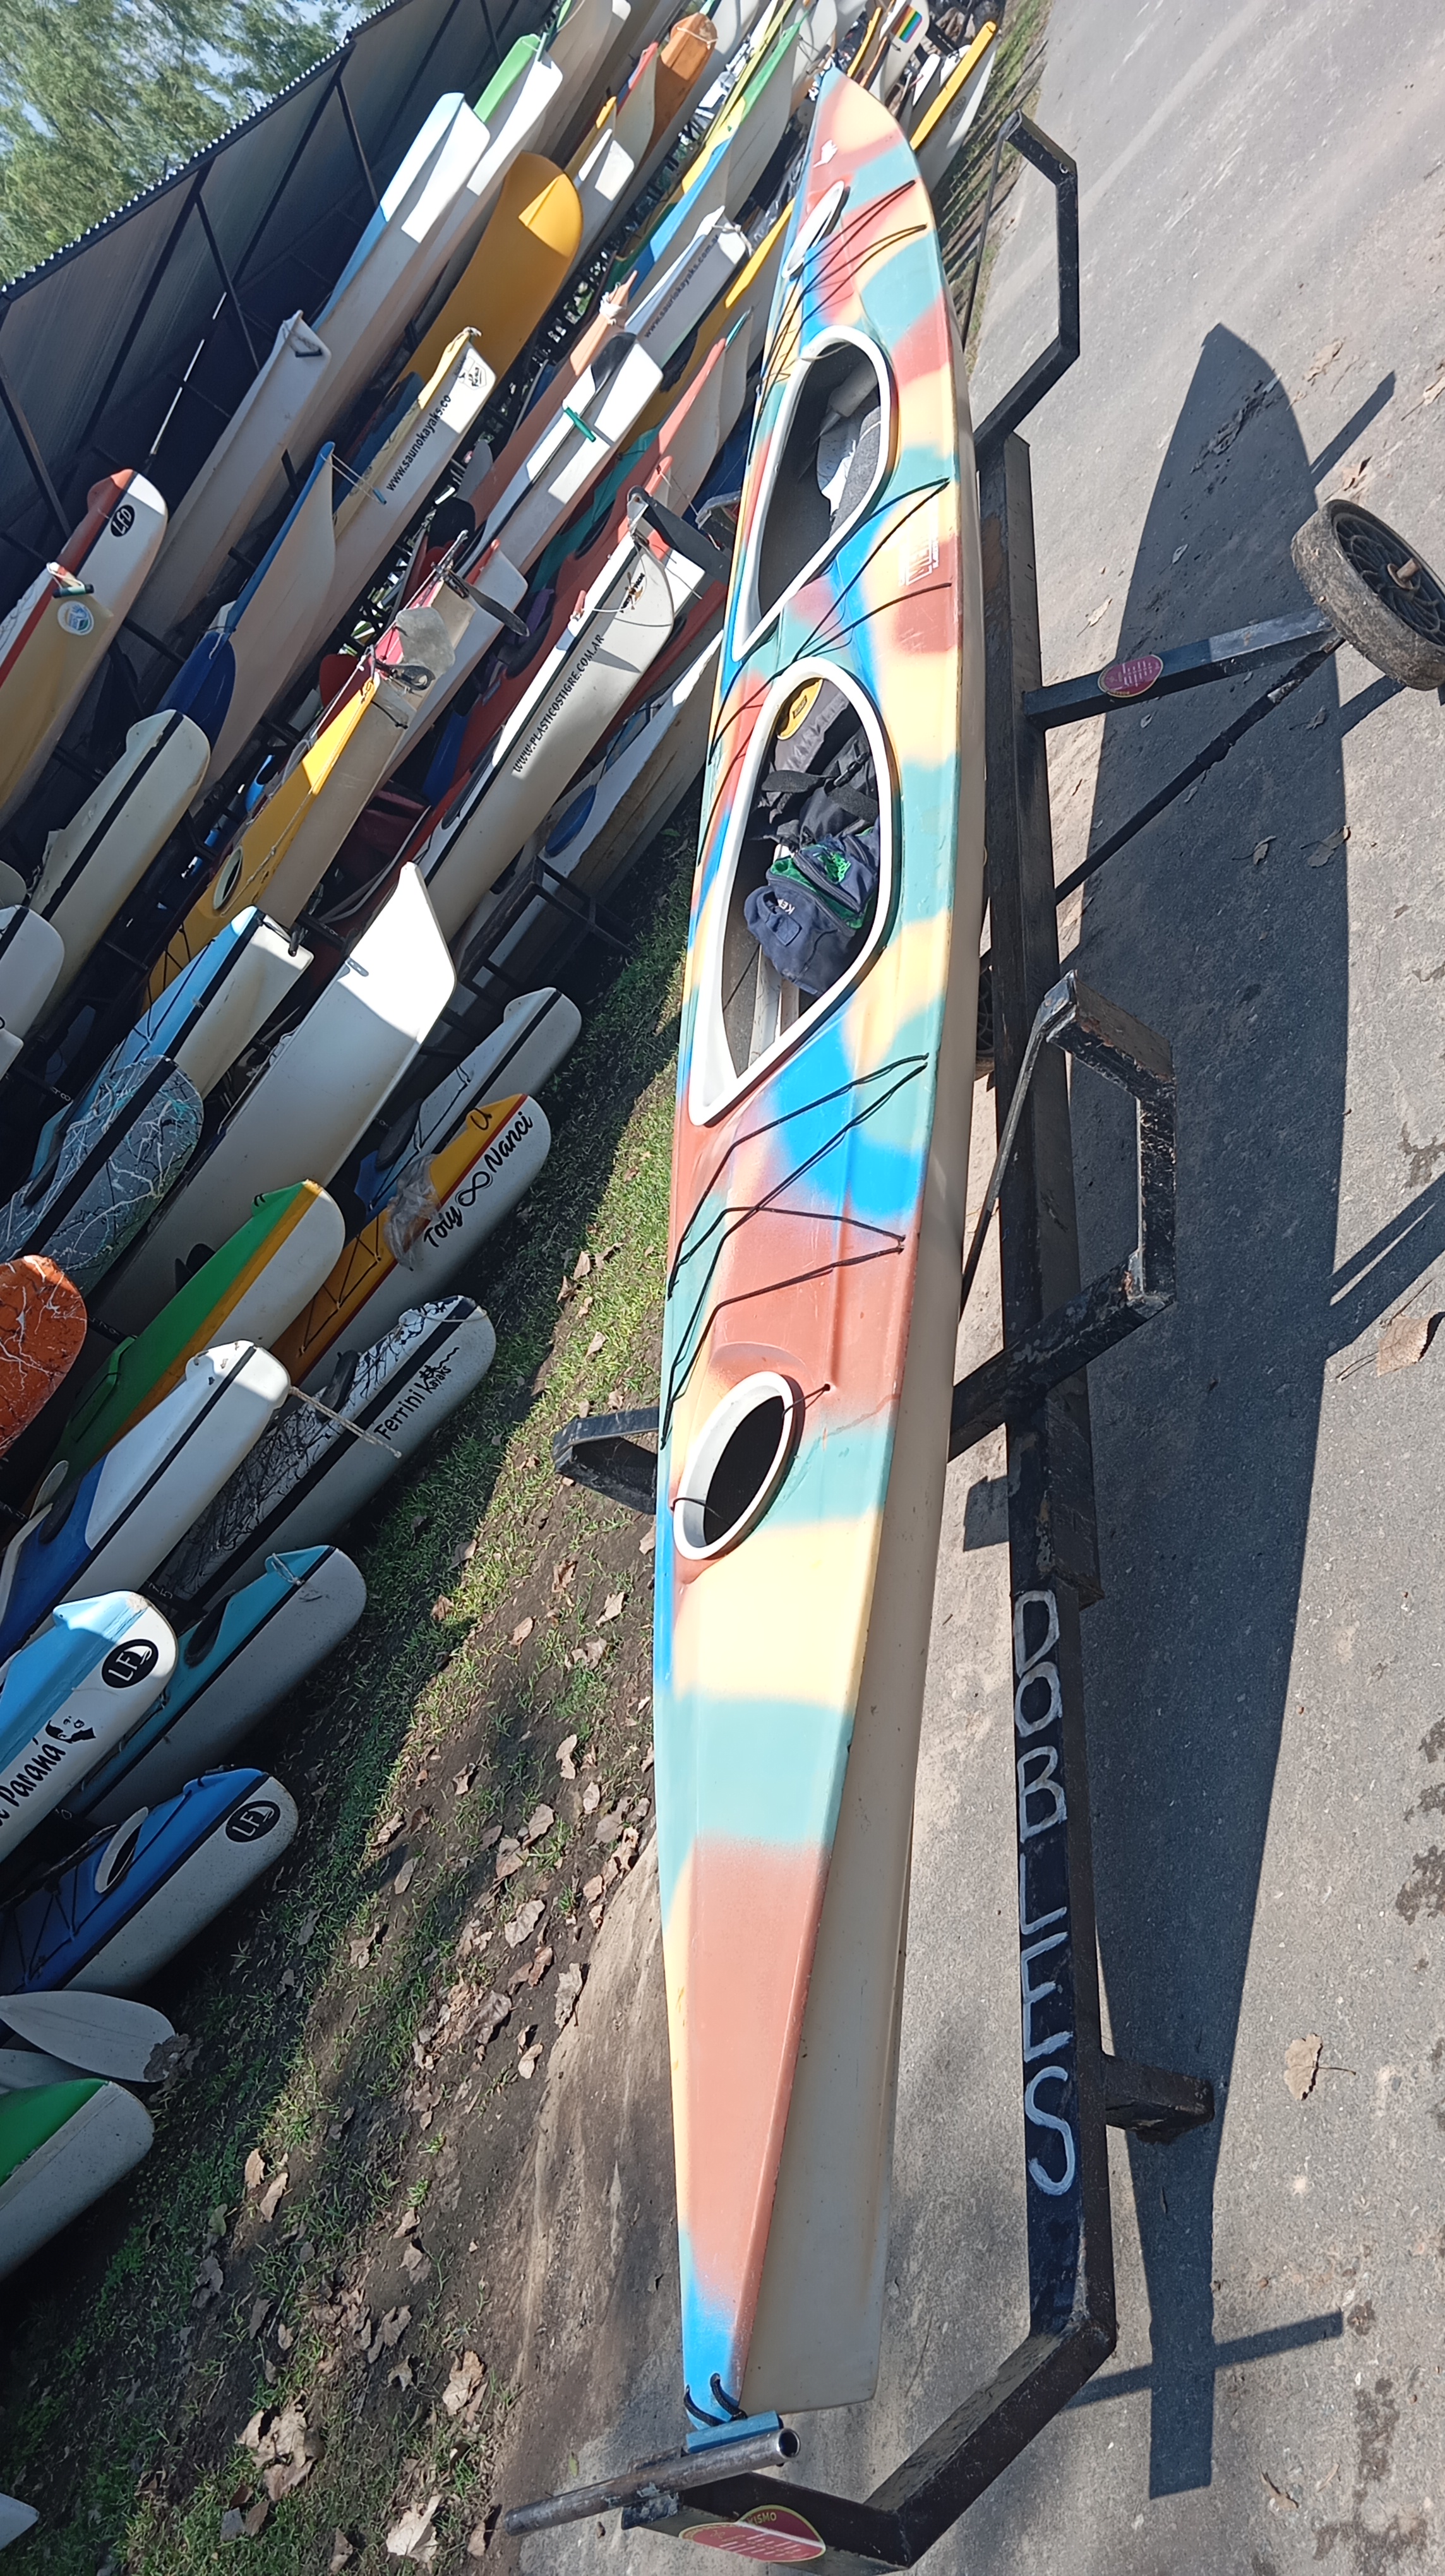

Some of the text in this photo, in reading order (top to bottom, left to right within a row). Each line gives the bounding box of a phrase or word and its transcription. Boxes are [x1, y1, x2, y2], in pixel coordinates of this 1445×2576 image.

[484, 1111, 534, 1173] Nanci
[374, 1390, 426, 1441] Ferrini
[0, 1738, 66, 1807] Paraná
[1014, 1589, 1075, 2196] DOBLES
